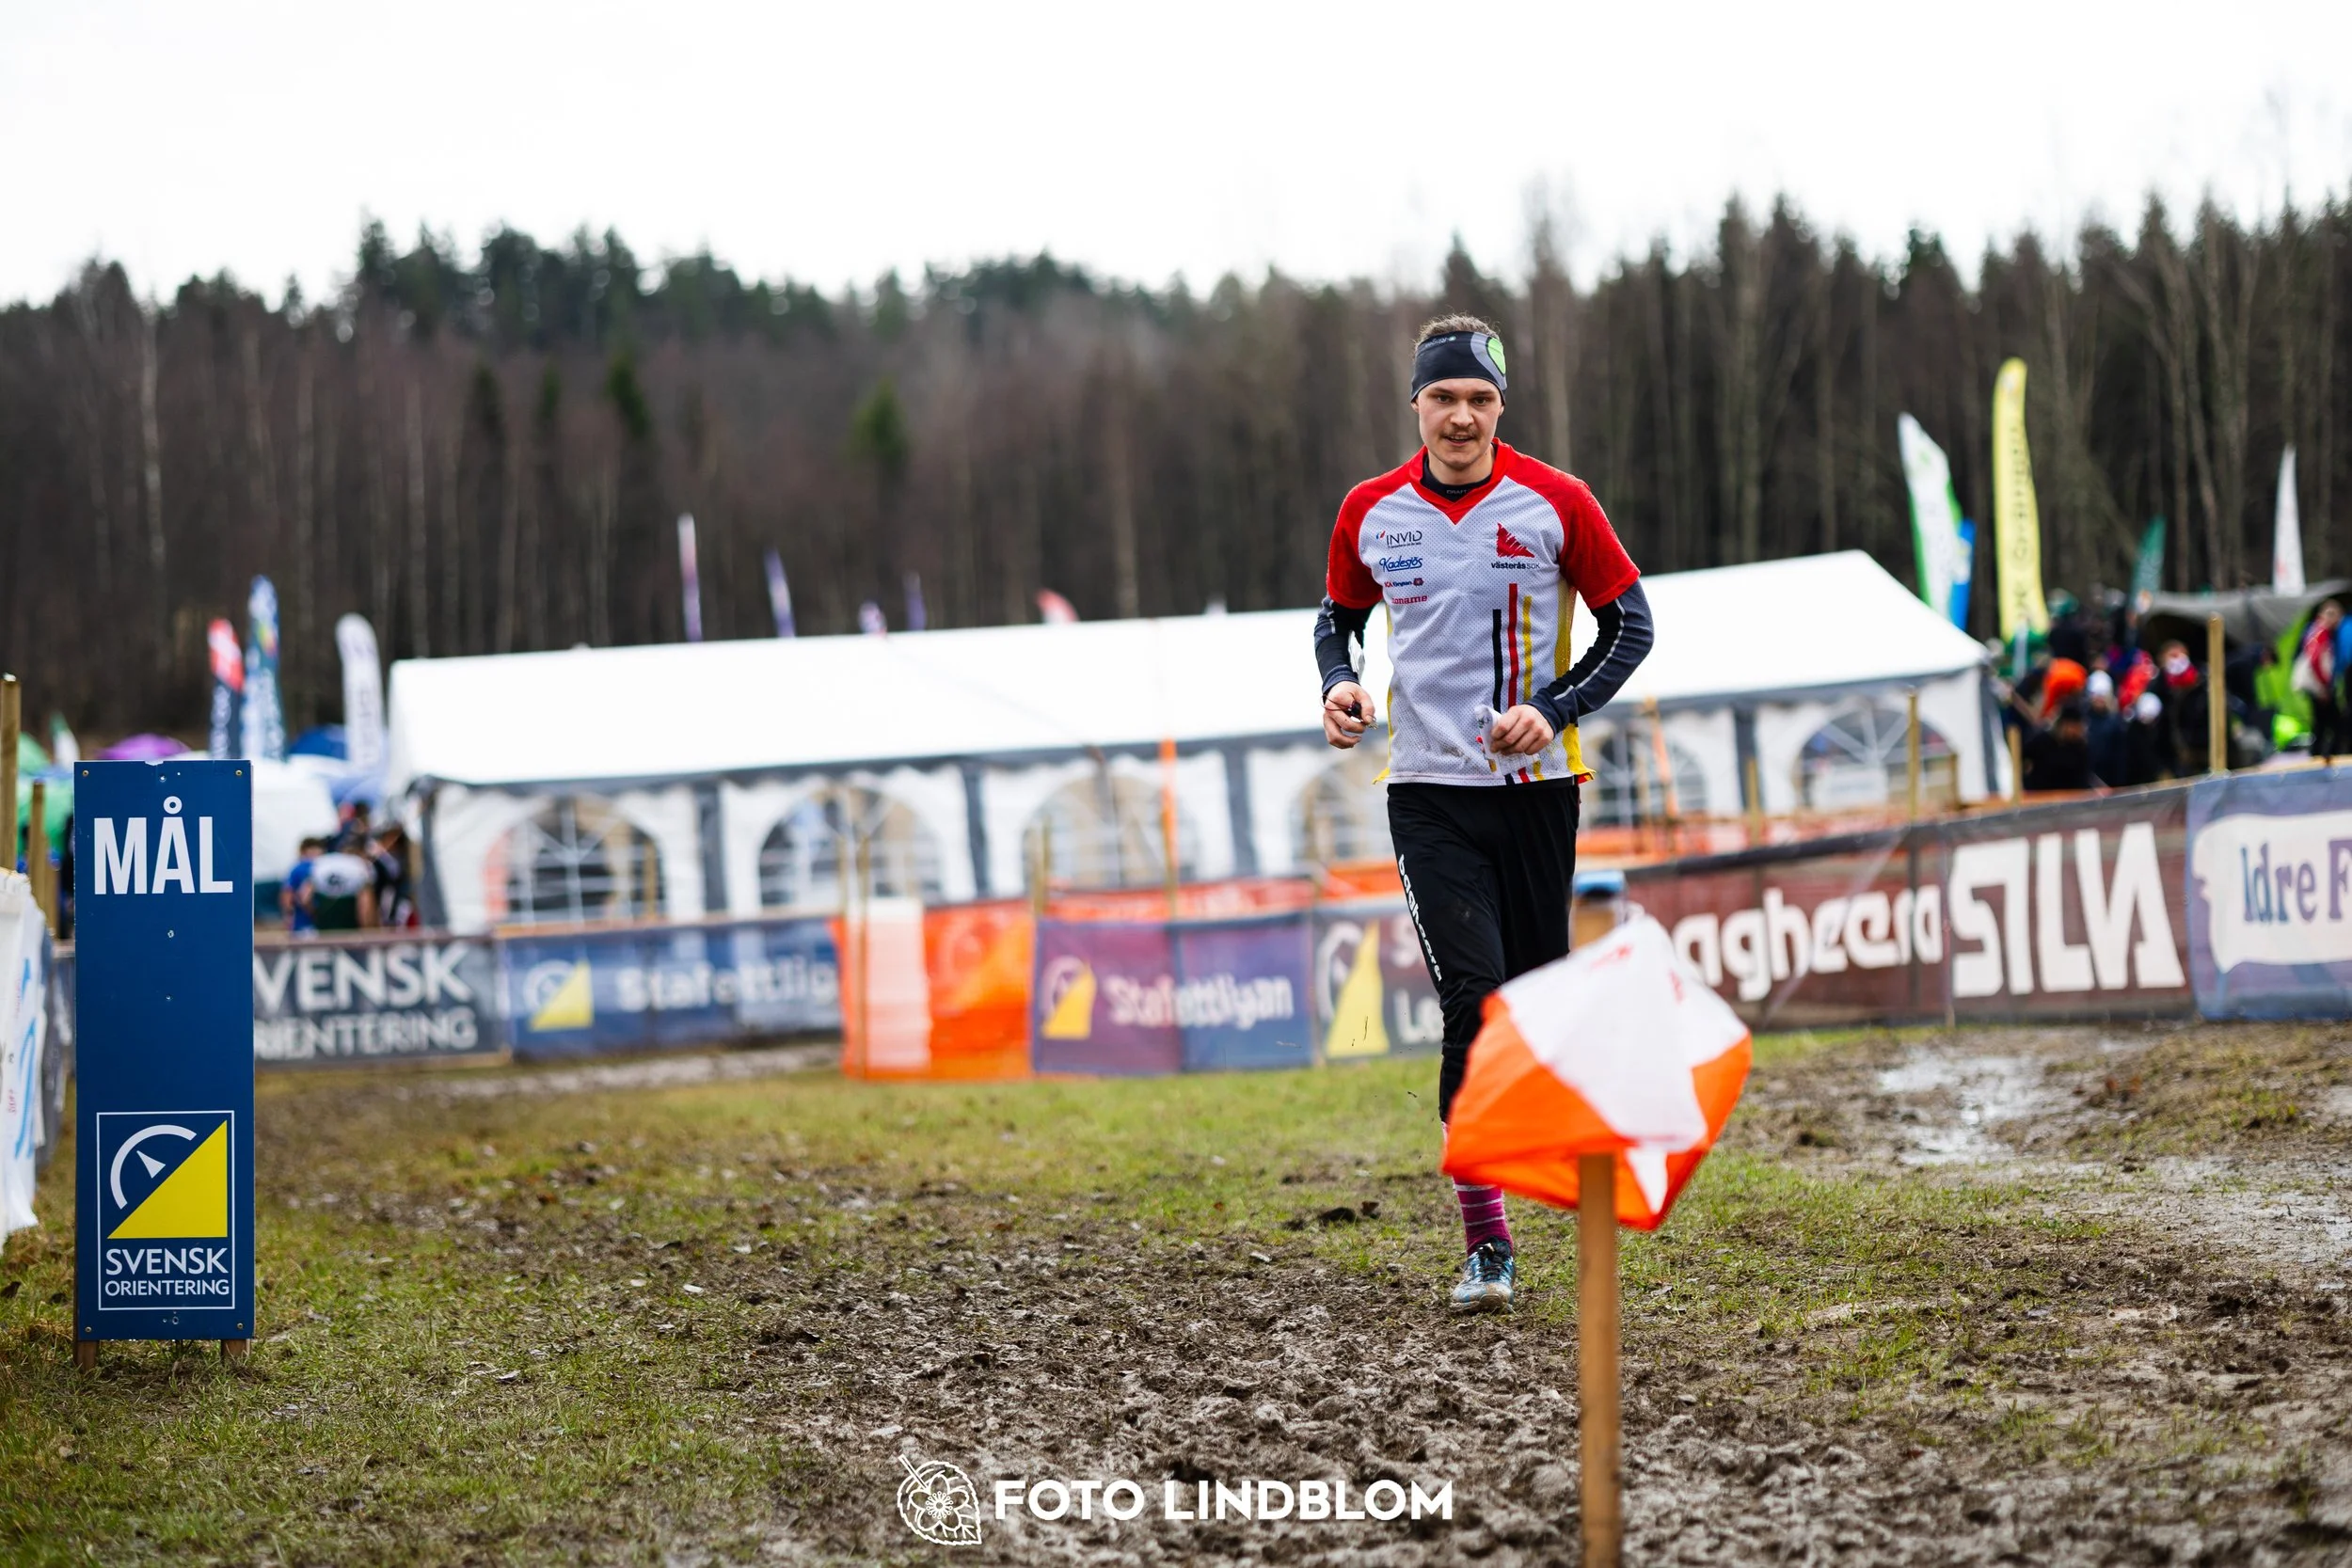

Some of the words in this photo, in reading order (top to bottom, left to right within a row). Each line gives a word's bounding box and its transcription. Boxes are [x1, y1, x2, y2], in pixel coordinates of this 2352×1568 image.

[1386, 531, 1422, 546] INVID
[94, 796, 233, 895] MÅL
[2240, 843, 2317, 924] Idre
[1672, 884, 1944, 1003] agheera
[253, 942, 474, 1013] VENSK
[615, 954, 840, 1013] Stafettlig
[253, 1006, 479, 1061] RIENTERING
[104, 1279, 230, 1296] ORIENTERING
[105, 1247, 229, 1275] SVENSK
